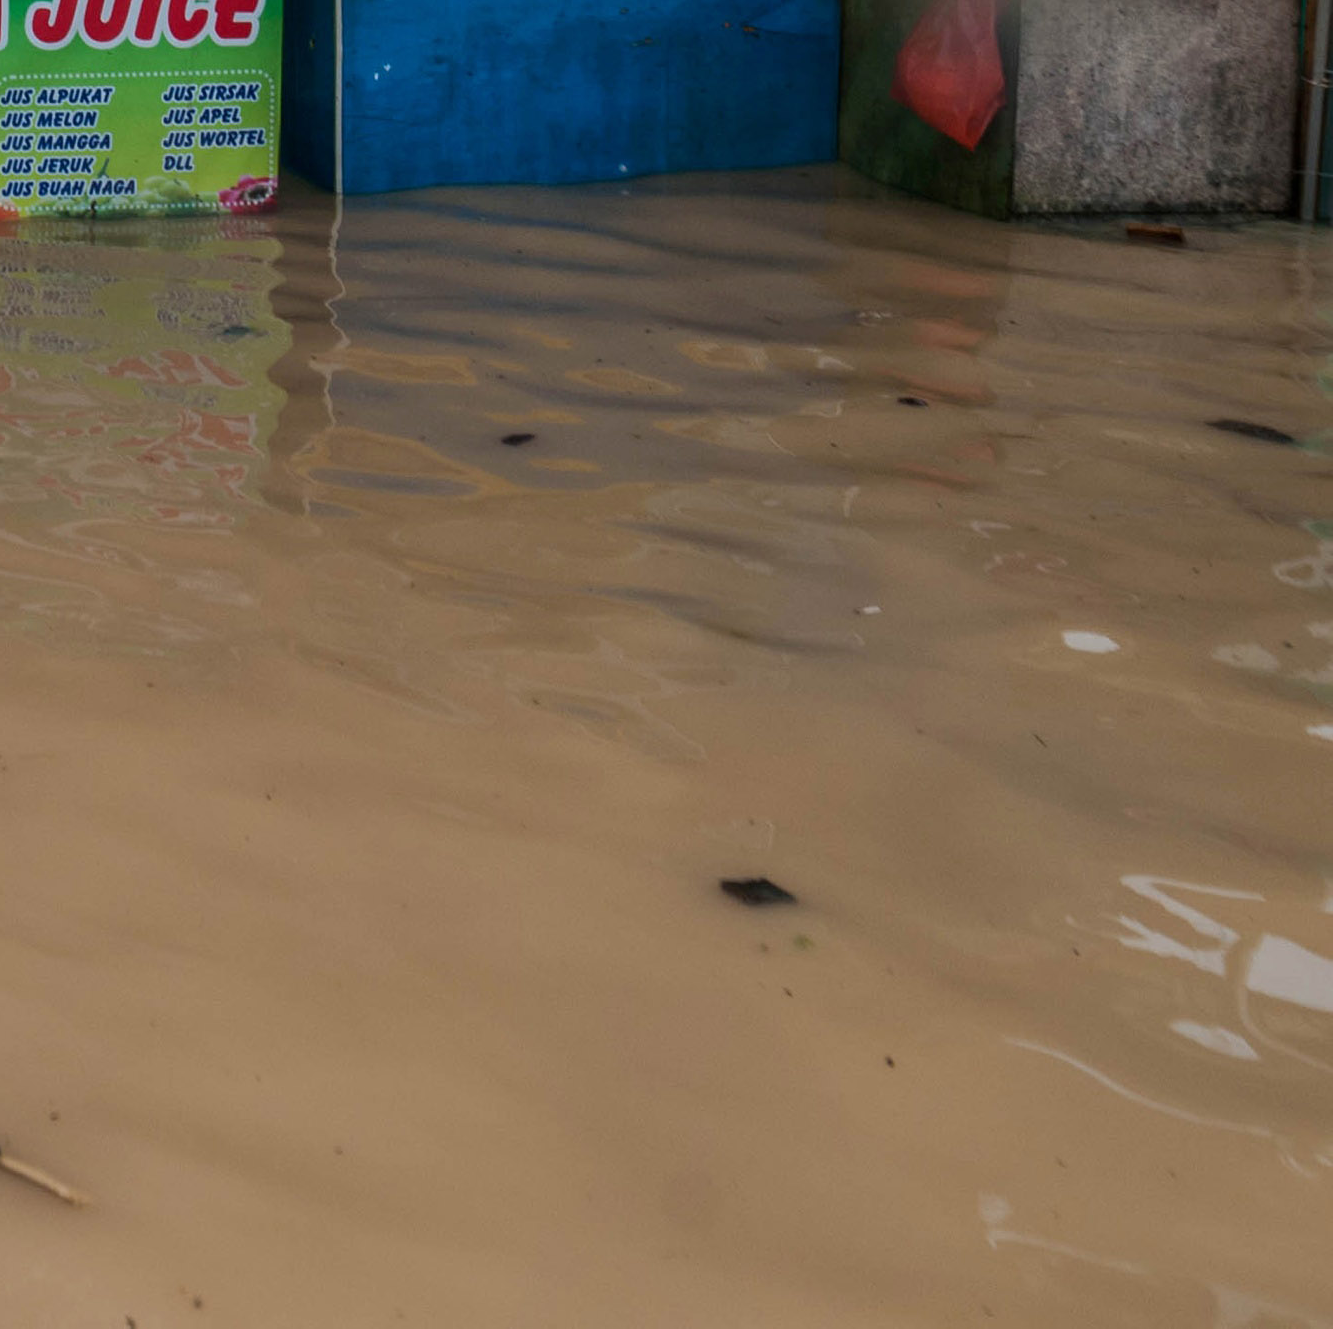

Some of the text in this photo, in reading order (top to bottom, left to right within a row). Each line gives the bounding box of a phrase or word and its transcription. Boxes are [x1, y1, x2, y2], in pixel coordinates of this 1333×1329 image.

[1, 87, 113, 105] JUS ALPUKAT
[163, 84, 260, 102] JUS SIRSAK
[1, 111, 97, 128] JUS MELON
[163, 108, 242, 125] JUS APEL
[1, 133, 111, 152] JUS MANGGA
[163, 130, 266, 148] JUS WORTEL
[1, 158, 94, 175] JUS JERUK
[163, 155, 195, 171] DLL
[1, 179, 136, 197] JUS BUAH NAGA
